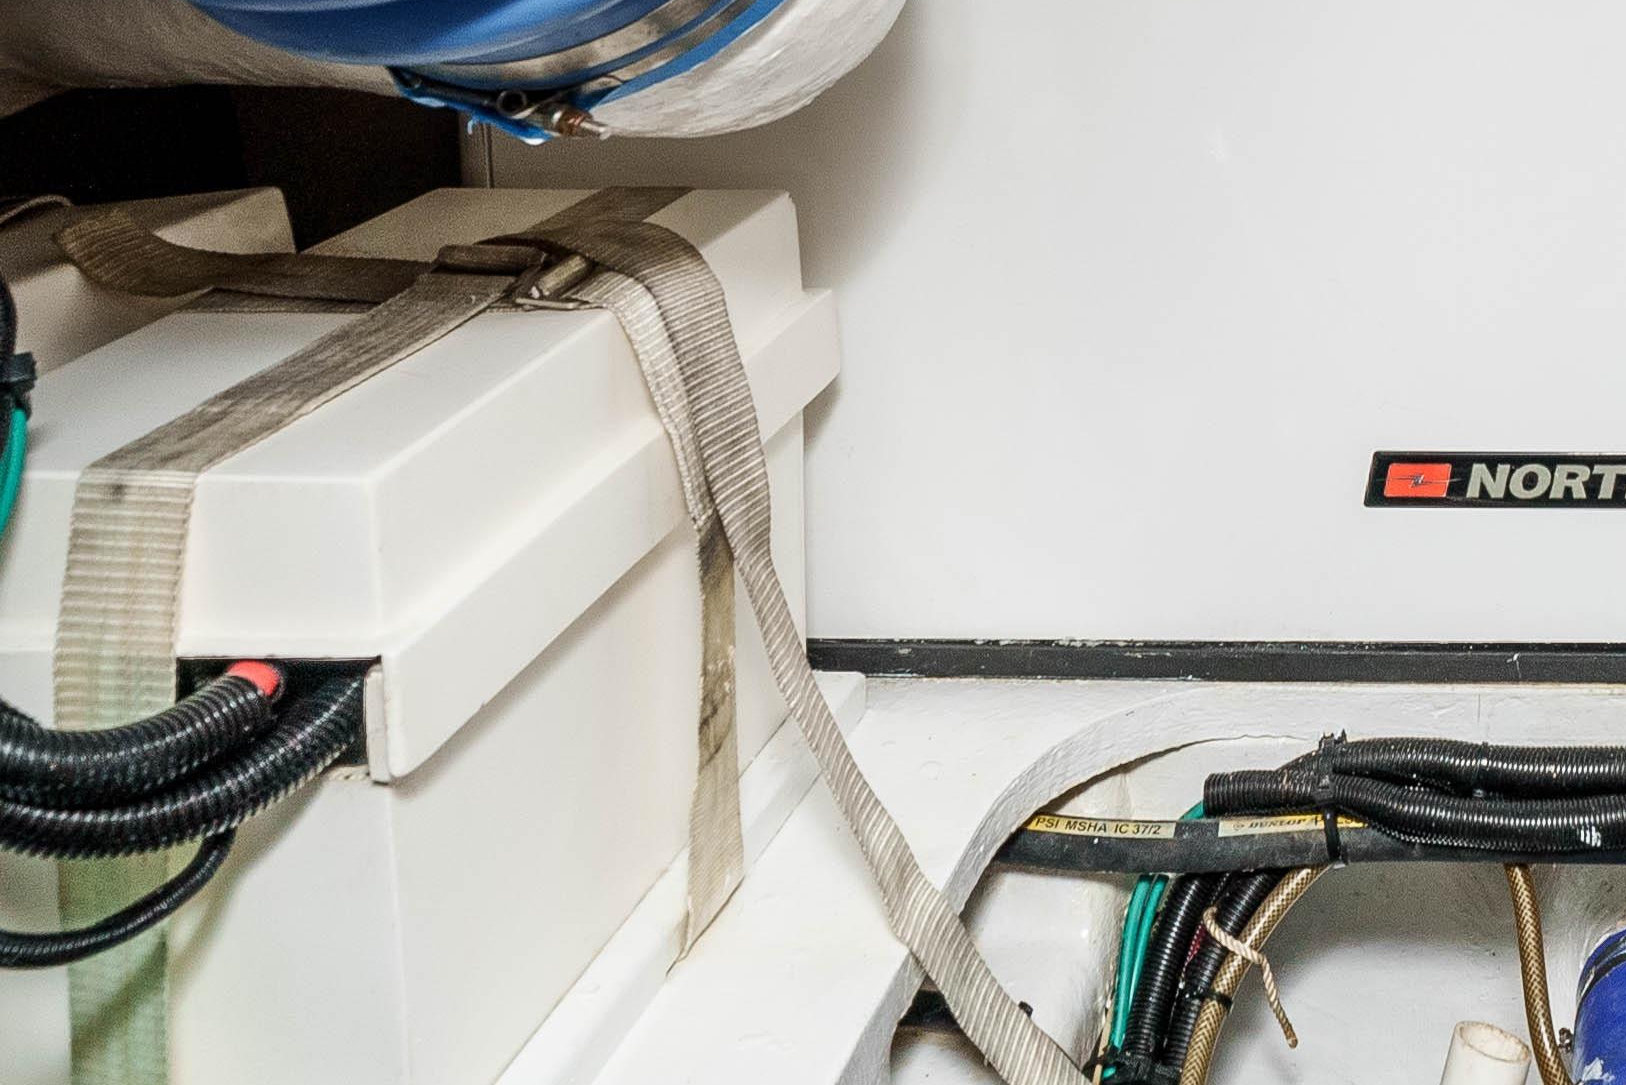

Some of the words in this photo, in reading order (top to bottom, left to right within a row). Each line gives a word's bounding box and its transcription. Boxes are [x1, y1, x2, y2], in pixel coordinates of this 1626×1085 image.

[1035, 817, 1060, 829] PSI
[1064, 820, 1107, 833] MSHA
[1113, 823, 1129, 834] IC
[1131, 824, 1162, 835] 37/2
[1248, 818, 1307, 829] DUNLOP
